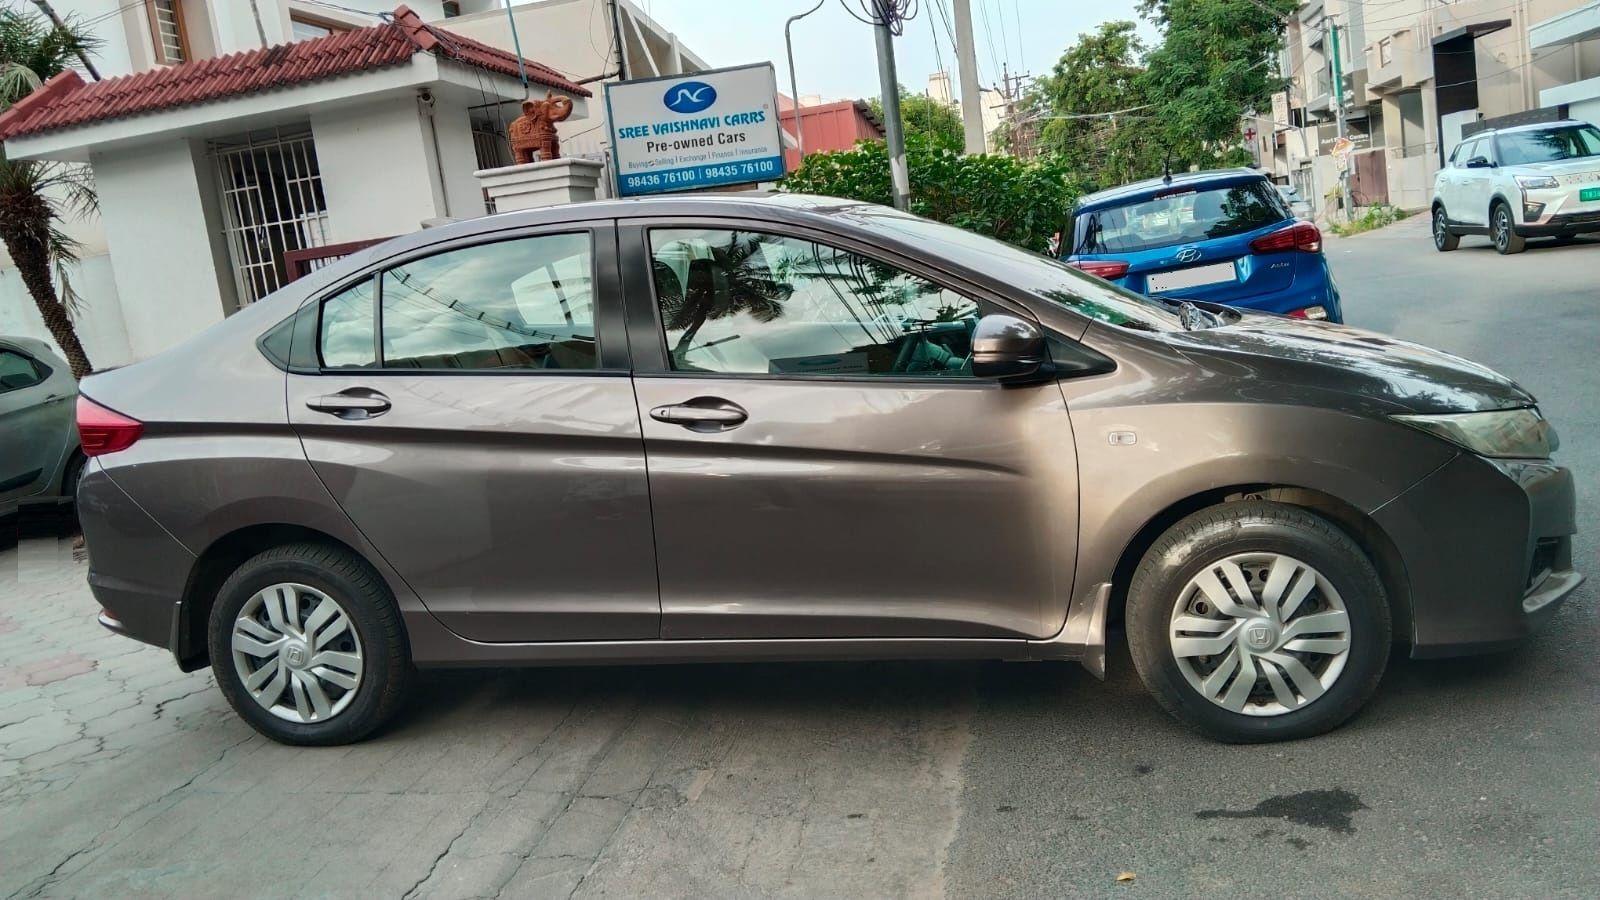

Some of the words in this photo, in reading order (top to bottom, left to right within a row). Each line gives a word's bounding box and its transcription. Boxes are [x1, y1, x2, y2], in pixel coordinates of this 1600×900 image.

[618, 125, 650, 140] SREE
[652, 117, 721, 135] VAISHNAVI
[724, 110, 766, 126] CARRS
[646, 134, 714, 153] Pre-owned
[718, 131, 747, 145] Cars
[627, 174, 660, 187] 98436
[662, 170, 695, 183] 76100
[705, 165, 738, 178] 98435
[740, 160, 773, 174] 76100
